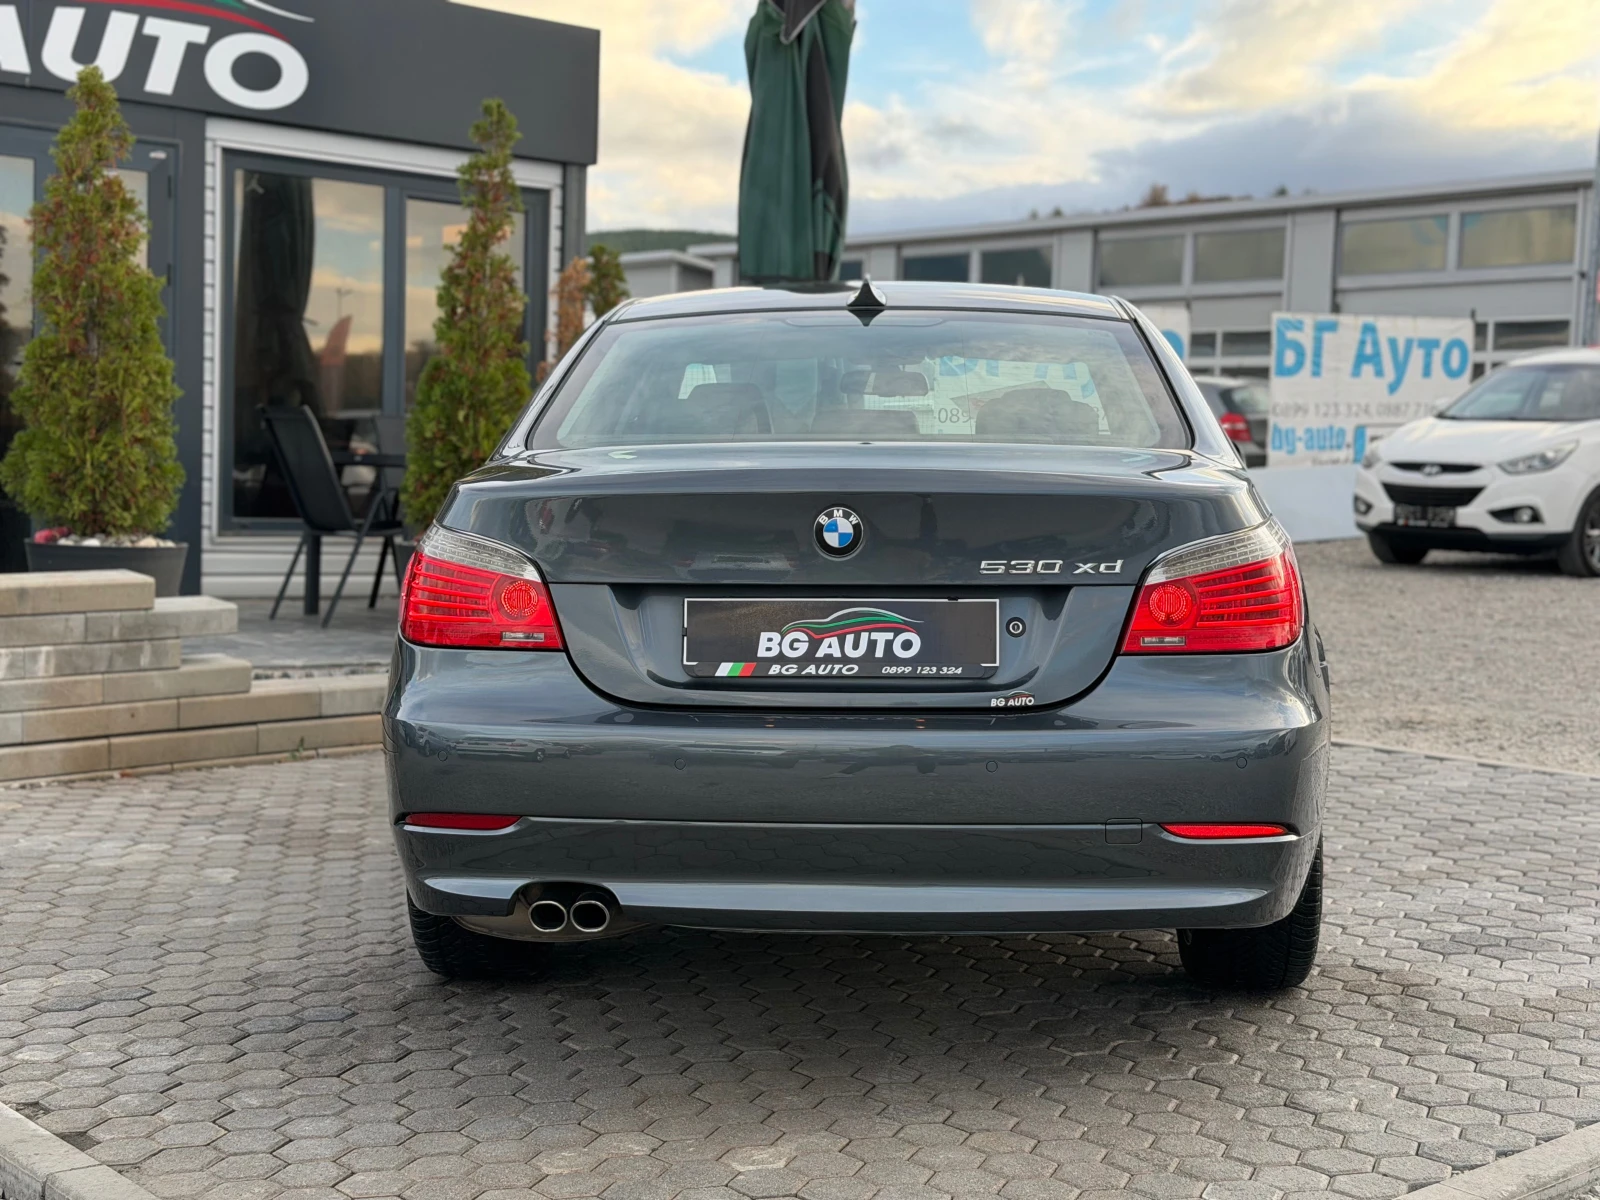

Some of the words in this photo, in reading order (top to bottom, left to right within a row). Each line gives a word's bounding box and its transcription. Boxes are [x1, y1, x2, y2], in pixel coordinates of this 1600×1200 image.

[1275, 318, 1338, 378] БГ
[1351, 322, 1470, 396] Ауто
[818, 509, 859, 526] BMW
[980, 560, 1063, 574] 530
[1072, 559, 1124, 574] xd
[757, 631, 809, 658] BG
[815, 631, 921, 658] AUTO
[768, 664, 798, 675] BG
[801, 664, 859, 675] AUTO
[881, 666, 912, 674] 0899
[916, 666, 937, 674] 123
[939, 666, 962, 674] 324
[991, 698, 1005, 707] BG
[1007, 696, 1035, 706] AUTO
